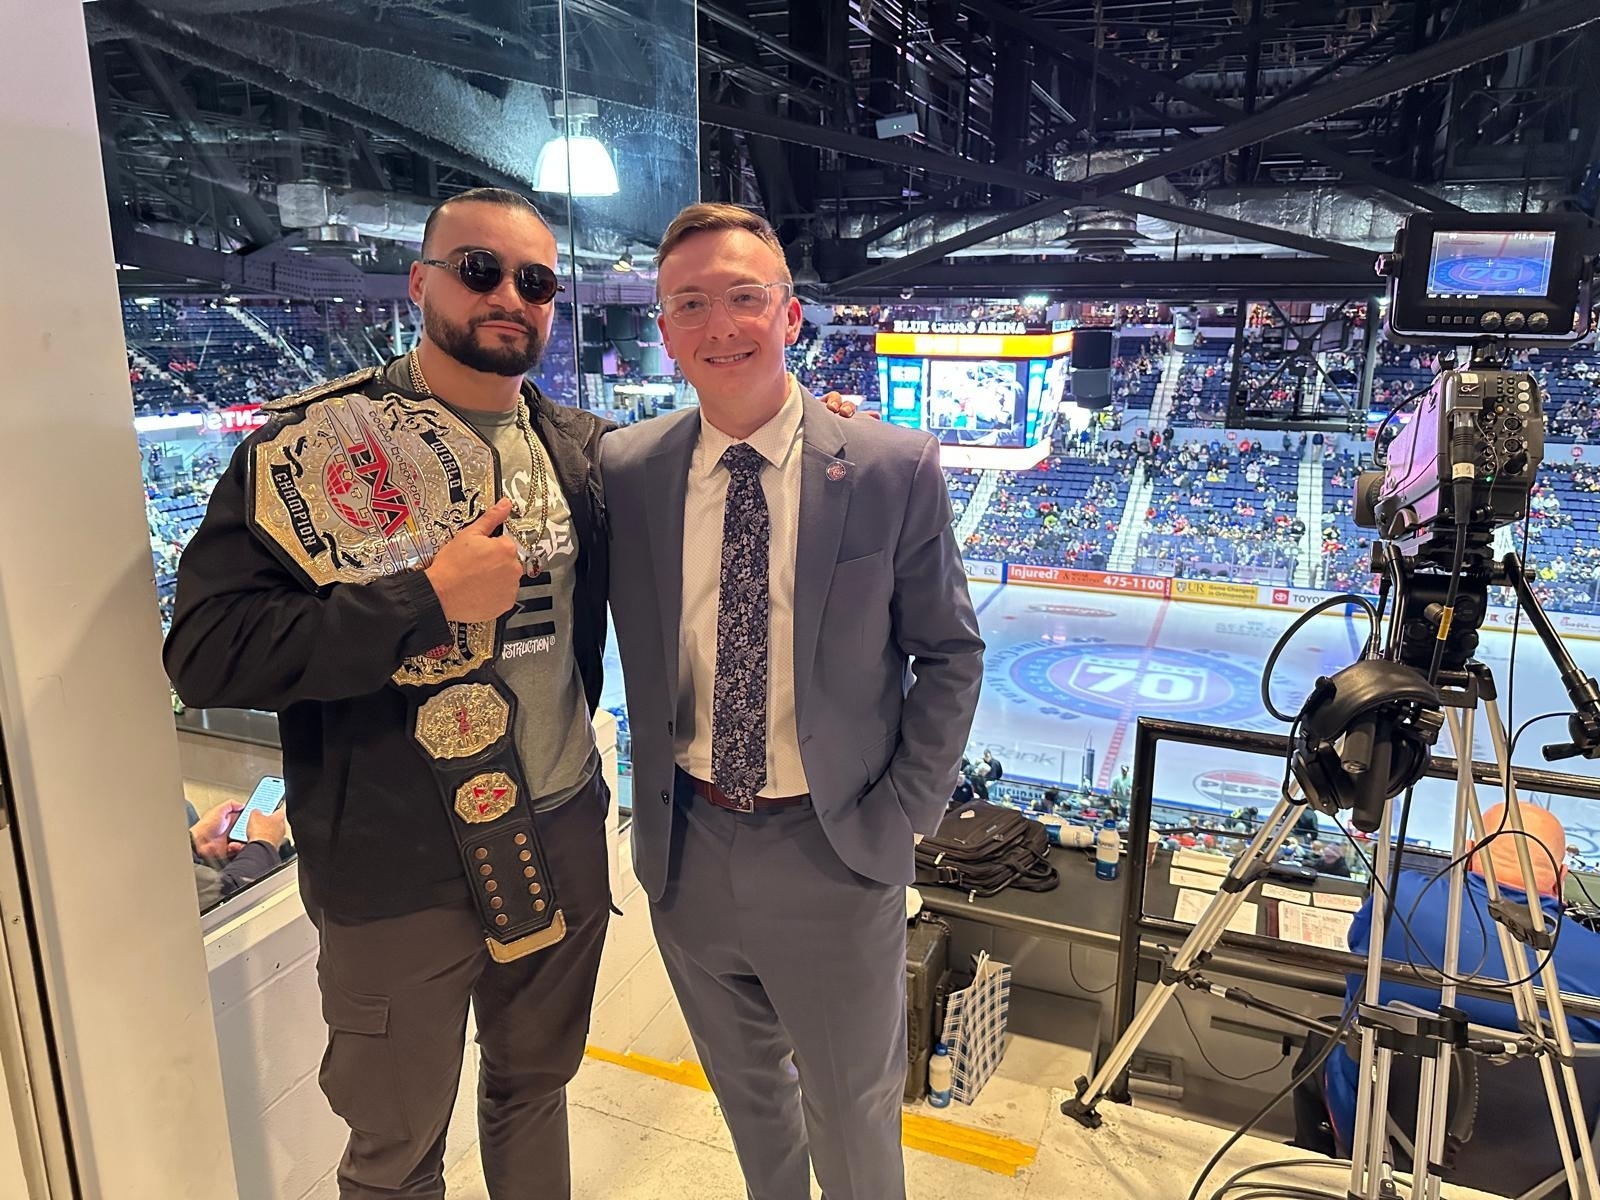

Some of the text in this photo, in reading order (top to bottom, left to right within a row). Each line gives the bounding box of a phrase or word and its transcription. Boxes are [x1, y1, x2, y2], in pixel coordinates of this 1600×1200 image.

[1467, 267, 1517, 280] 70
[893, 320, 1027, 334] BLUE CROSS ARENA
[431, 441, 461, 489] WORLD
[346, 423, 411, 541] TNA
[274, 471, 317, 547] CHAMPION
[1011, 566, 1060, 580] Injured?
[1103, 575, 1165, 591] 475-1100
[1187, 580, 1205, 593] UR
[1293, 594, 1327, 604] TOYO
[458, 625, 470, 654] ORLD
[1085, 664, 1196, 702] 70
[994, 786, 1042, 800] INSURAN
[1200, 779, 1280, 798] PEPS
